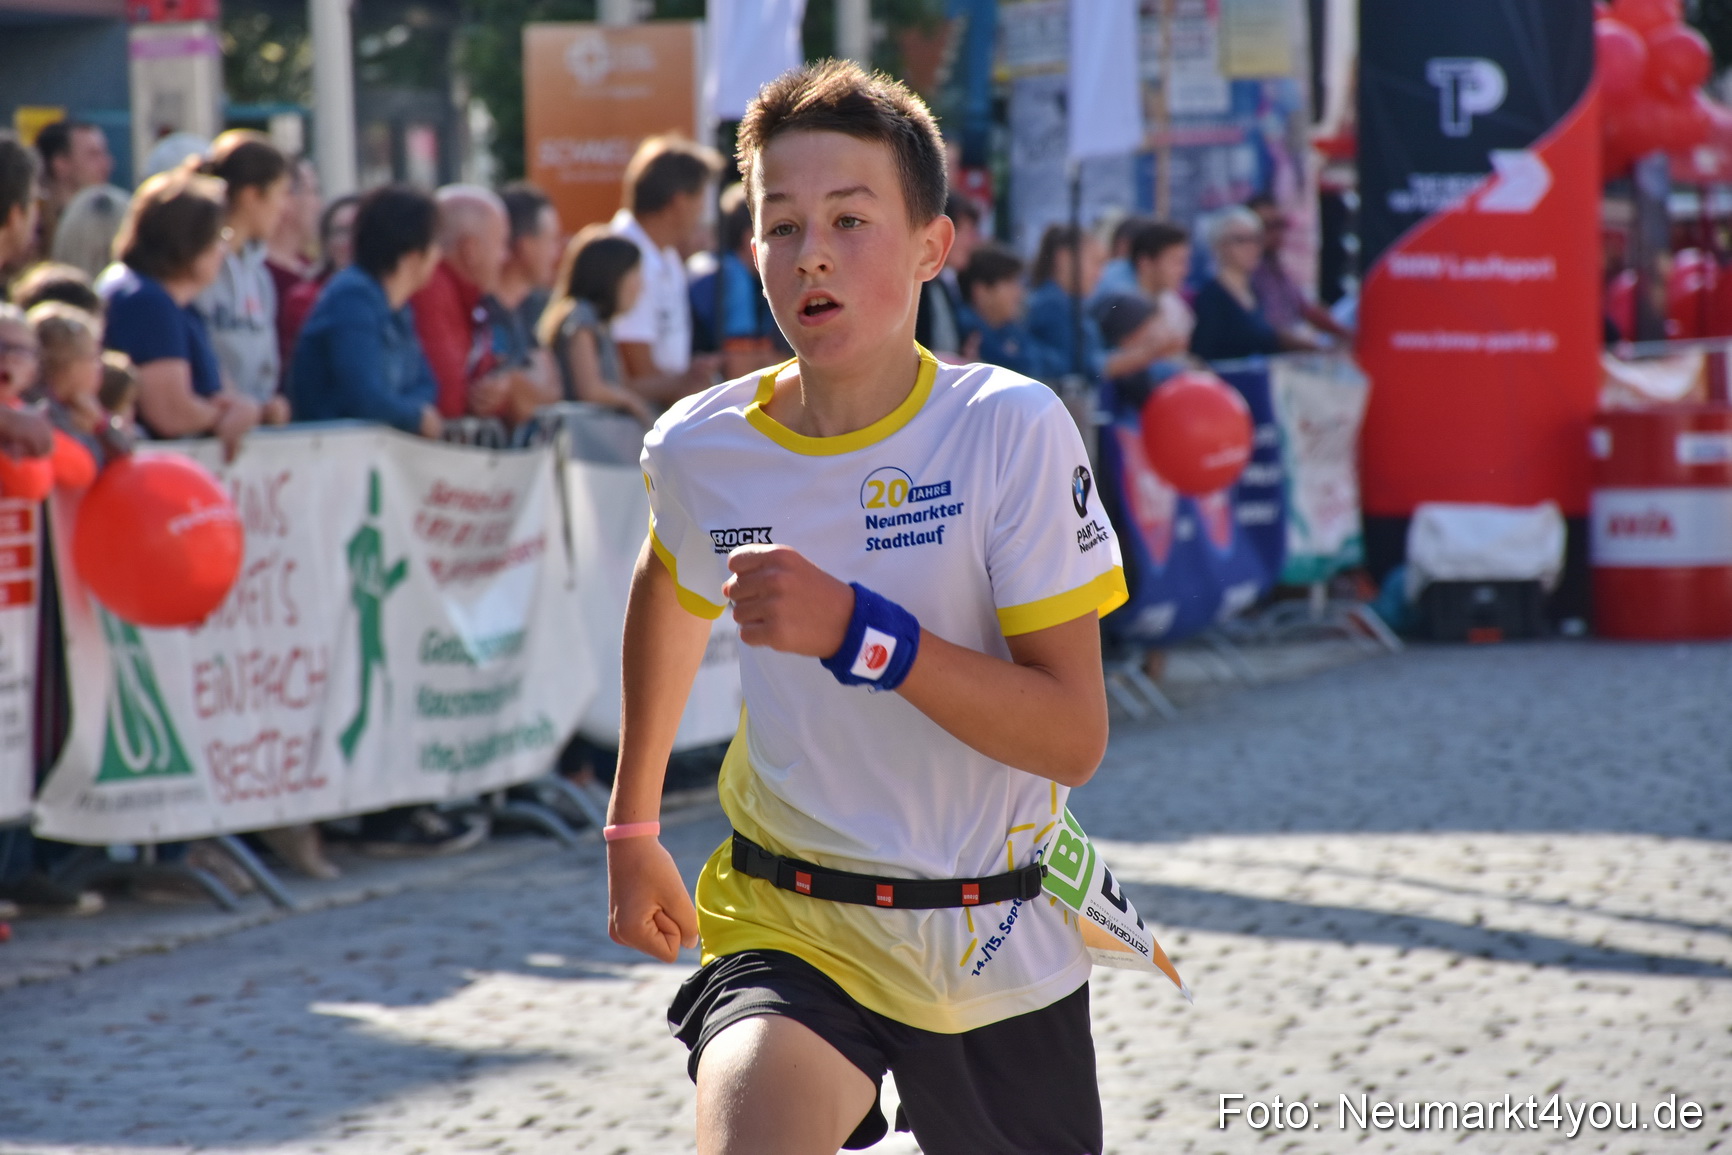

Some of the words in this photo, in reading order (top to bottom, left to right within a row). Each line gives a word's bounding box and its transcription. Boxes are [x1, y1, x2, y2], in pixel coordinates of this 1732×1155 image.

[866, 478, 909, 509] 20
[911, 483, 948, 502] JAHRE
[865, 502, 964, 530] Neumarkter
[710, 527, 773, 547] BOCK
[865, 524, 945, 552] Stadtlauf
[971, 935, 1006, 976] 14./15.
[998, 897, 1023, 935] Sept
